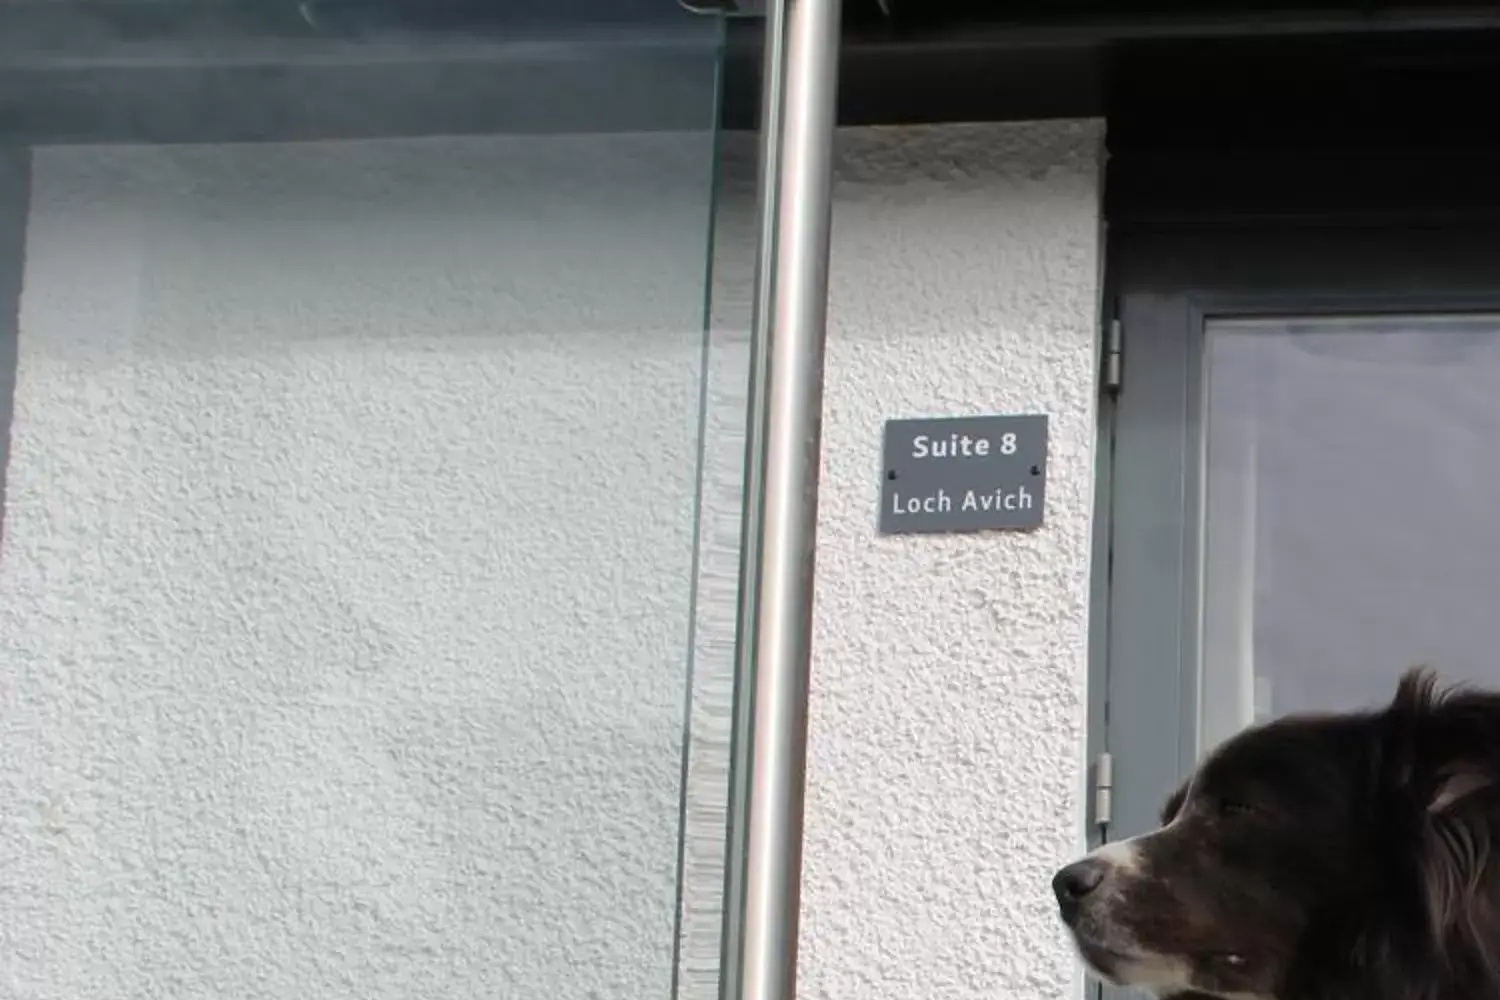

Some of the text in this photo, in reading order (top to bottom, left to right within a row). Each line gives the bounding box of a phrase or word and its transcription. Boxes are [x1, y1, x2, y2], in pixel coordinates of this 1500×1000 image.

[912, 433, 1017, 458] Suite 8
[893, 486, 1032, 514] Loch Avich
